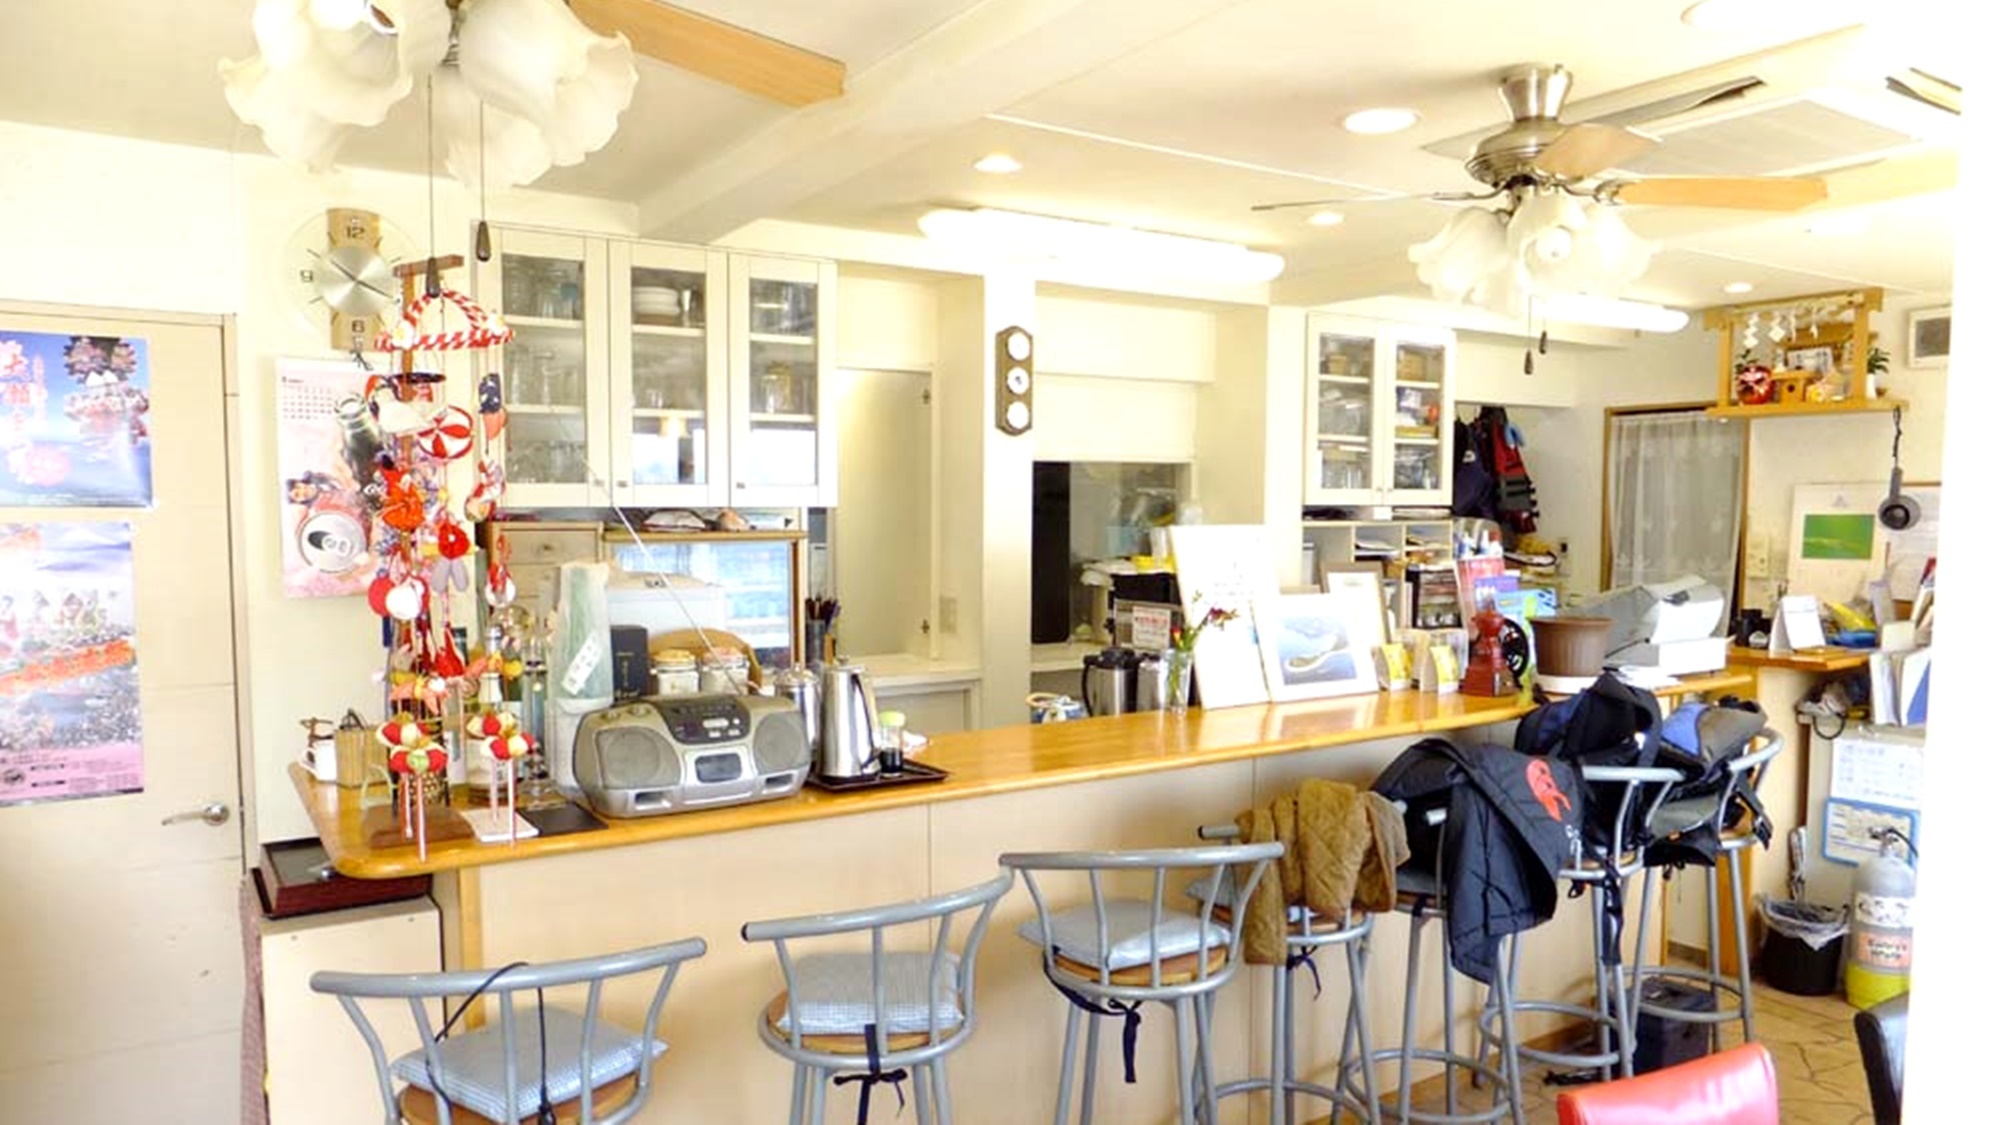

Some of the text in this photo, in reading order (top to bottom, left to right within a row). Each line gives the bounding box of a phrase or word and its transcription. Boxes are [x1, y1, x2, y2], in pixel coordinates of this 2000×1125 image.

[346, 226, 365, 239] 12
[300, 270, 313, 282] 9
[352, 320, 365, 333] 6
